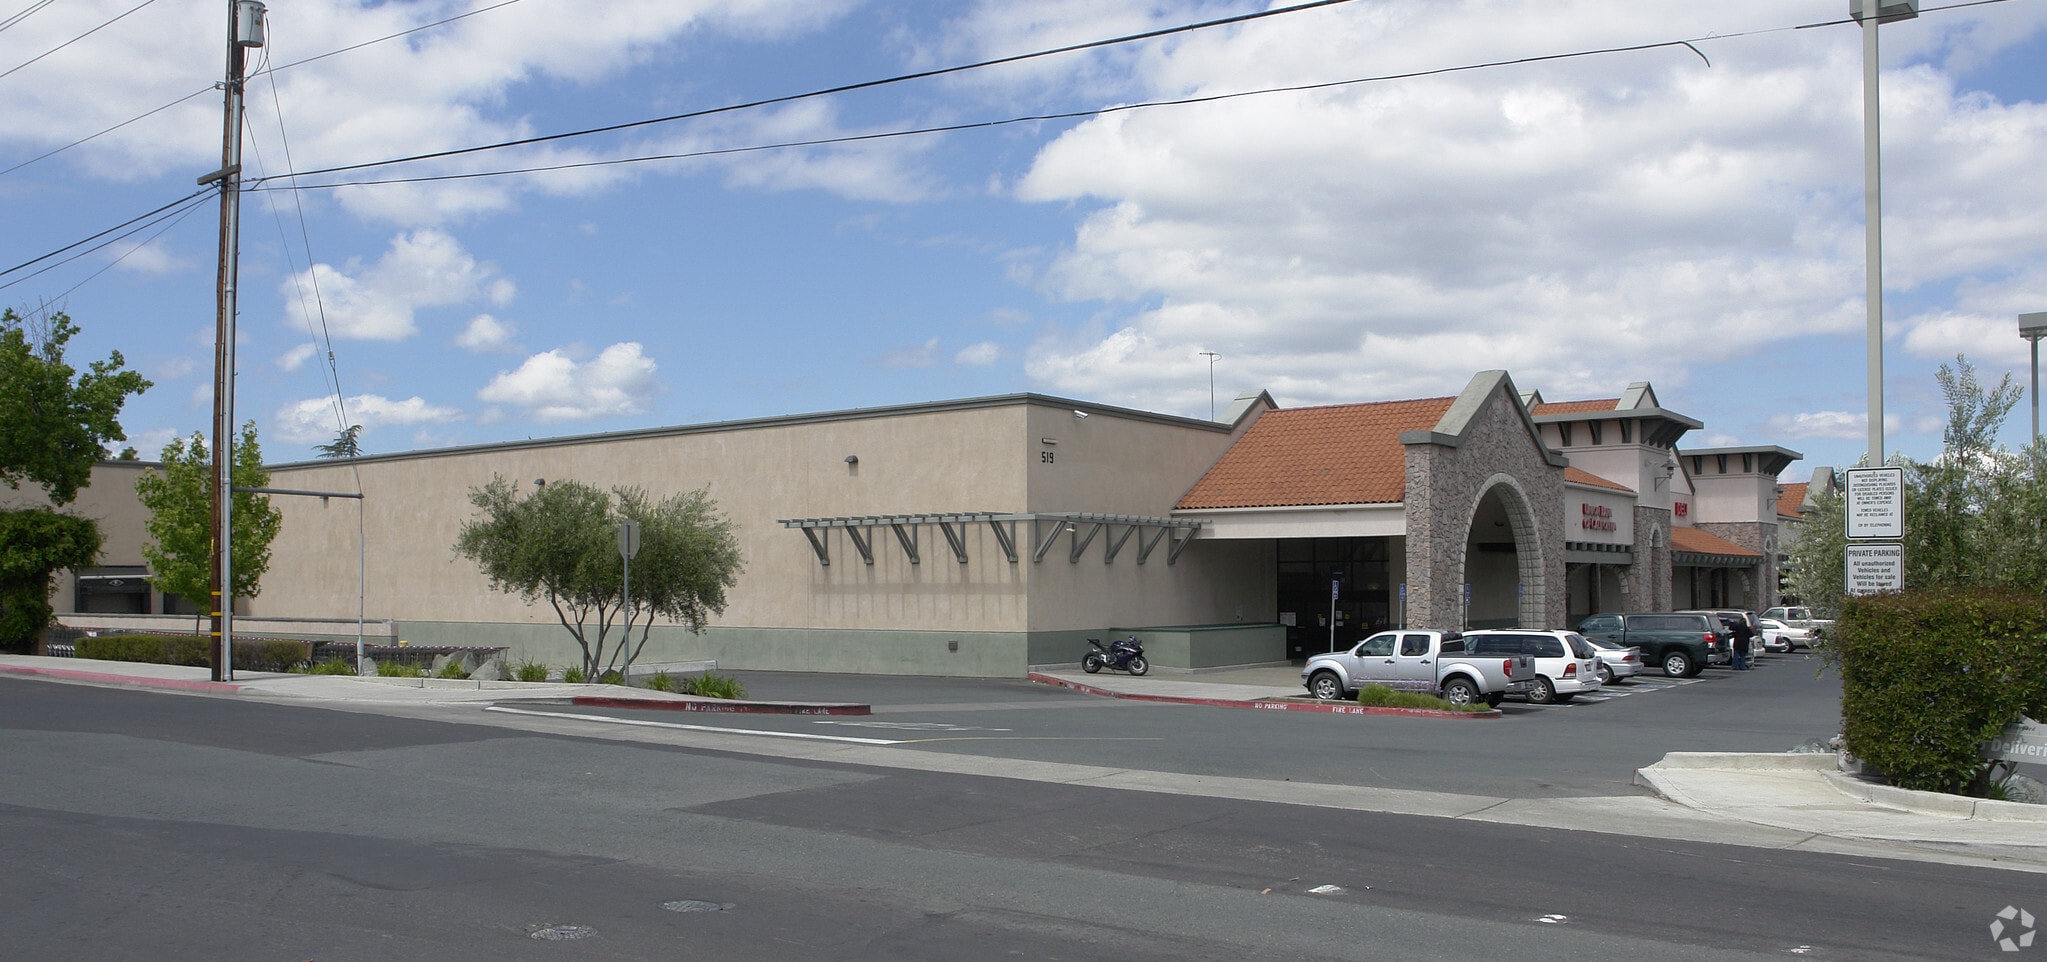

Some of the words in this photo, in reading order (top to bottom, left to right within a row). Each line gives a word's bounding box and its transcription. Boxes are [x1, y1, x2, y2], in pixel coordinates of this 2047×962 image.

[1042, 452, 1053, 463] 519
[685, 702, 697, 711] NO
[701, 703, 735, 712] PARKING
